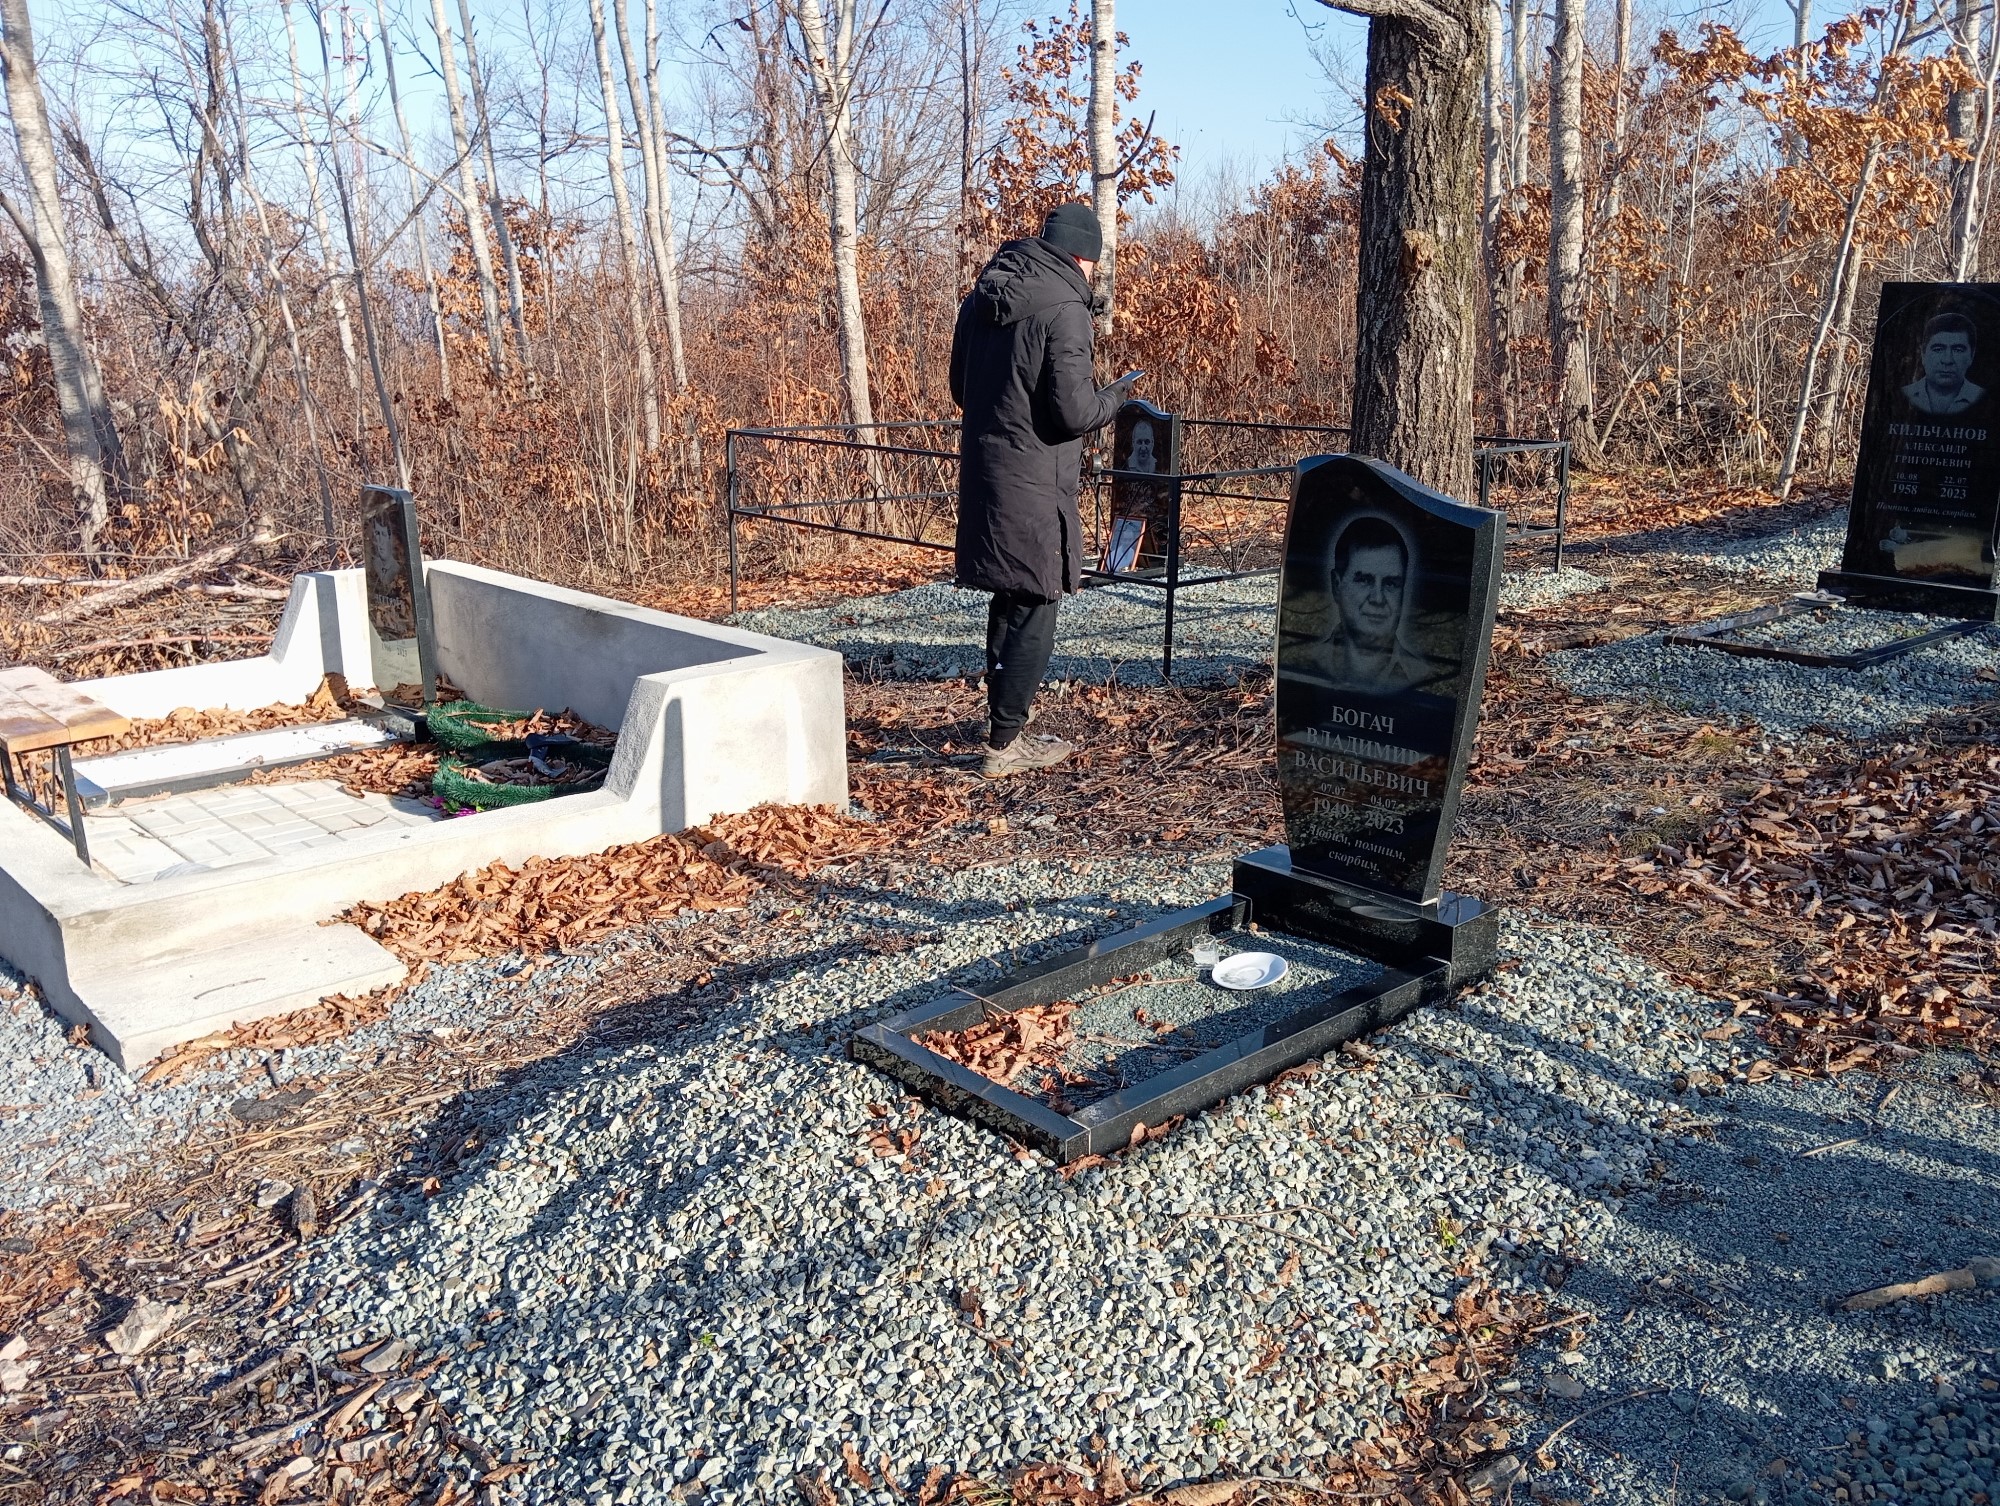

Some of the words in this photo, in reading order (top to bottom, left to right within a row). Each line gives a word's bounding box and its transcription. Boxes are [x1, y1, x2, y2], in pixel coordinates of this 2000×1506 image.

[1889, 424, 1986, 440] КИЛЬЧАНОВ
[1895, 455, 1972, 468] ГРИГОРЬЕВИЧ
[1904, 442, 1967, 454] АЛЕКСАНДР
[1892, 483, 1918, 495] 1958
[1940, 487, 1966, 499] 2023
[1332, 706, 1394, 734] БОГАЧ
[1306, 727, 1420, 766] ВЛАДИМИР
[1294, 751, 1430, 798] ВАСИЛЬЕВИЧ
[1321, 782, 1346, 797] 07.07
[1370, 795, 1397, 810] 04.07
[1312, 797, 1350, 820] 1949
[1364, 810, 1404, 835] 2023
[1306, 823, 1351, 846] Любим,
[1354, 839, 1406, 863] помним,
[1328, 850, 1380, 872] скорбим.
